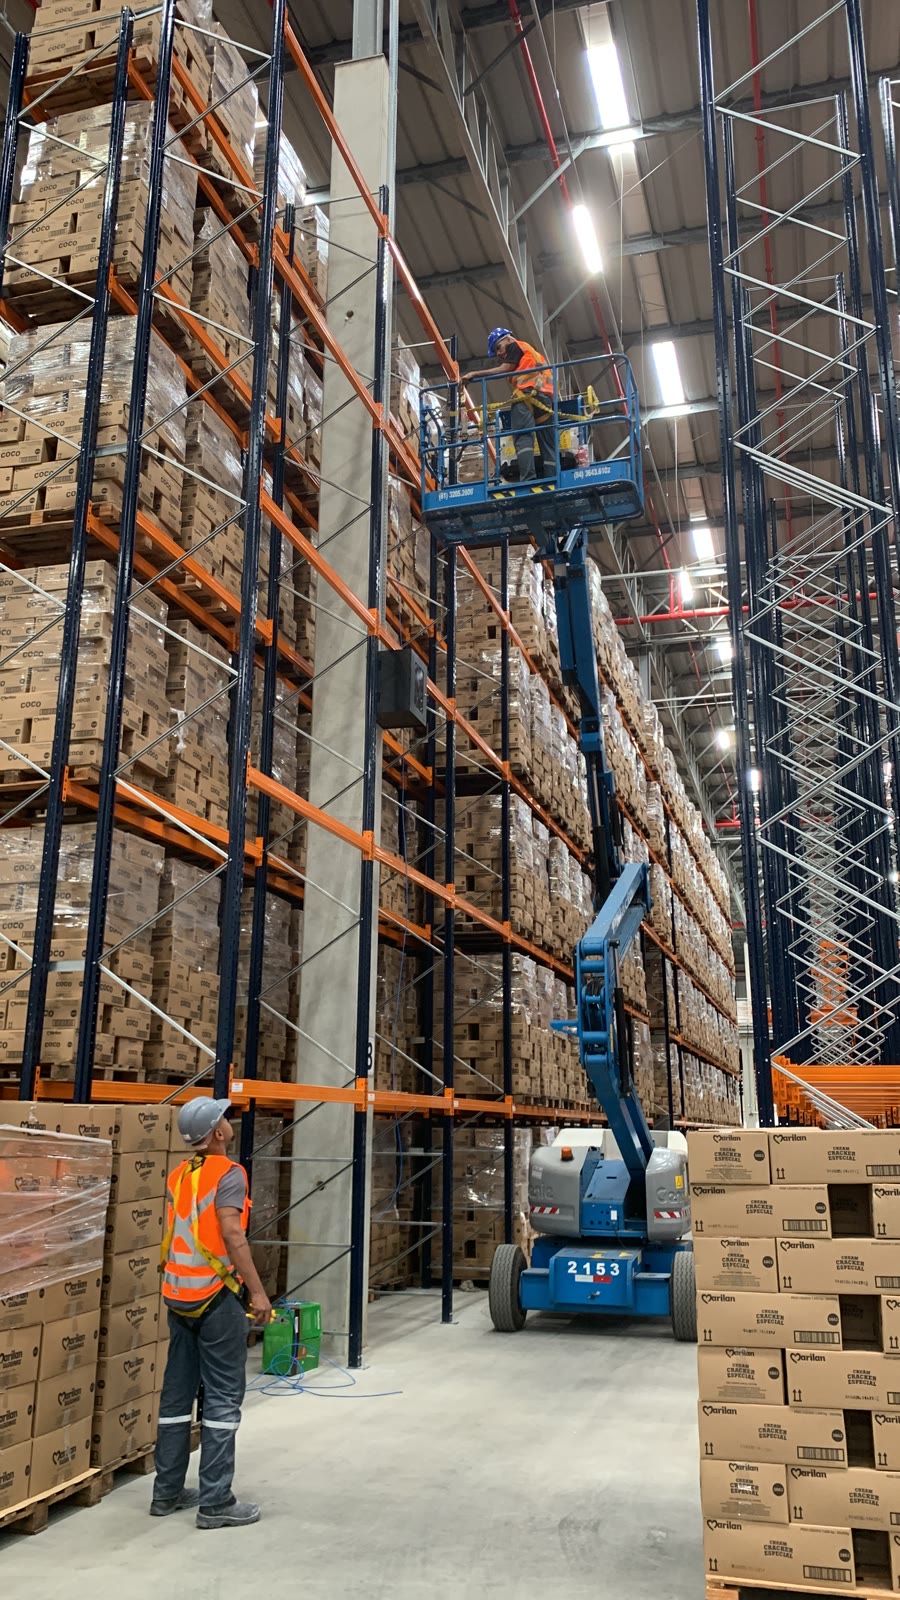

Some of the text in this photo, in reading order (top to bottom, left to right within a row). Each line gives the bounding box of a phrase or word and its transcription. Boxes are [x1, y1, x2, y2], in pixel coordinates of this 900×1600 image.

[55, 6, 73, 14] COCO
[48, 43, 66, 52] COCO
[39, 184, 57, 192] COCO
[66, 198, 84, 207] COCO
[58, 240, 78, 249] COCO
[46, 420, 65, 429] COCO
[1, 450, 20, 458] COCO
[0, 499, 15, 507] OCO
[20, 701, 41, 709] COCO
[2, 922, 24, 930] COCO
[713, 1134, 741, 1143] Marilan
[773, 1134, 807, 1144] Marilan
[693, 1186, 725, 1197] Marilan
[874, 1188, 900, 1198] Maril
[720, 1239, 749, 1248] Marilan
[780, 1241, 815, 1251] Marilan
[567, 1261, 620, 1276] 2153
[701, 1294, 735, 1304] Marilan
[725, 1348, 754, 1358] Marilan
[790, 1352, 826, 1364] Marilan
[702, 1405, 737, 1416] Marilan
[875, 1414, 900, 1426] Maril
[728, 1463, 758, 1472] Marilan
[790, 1468, 827, 1479] Marilan
[849, 1492, 880, 1500] CRACKER
[850, 1498, 880, 1506] ESPECIAL
[706, 1519, 742, 1531] Marilan
[763, 1545, 793, 1553] CRACKER
[764, 1551, 793, 1559] ESPECIAL
